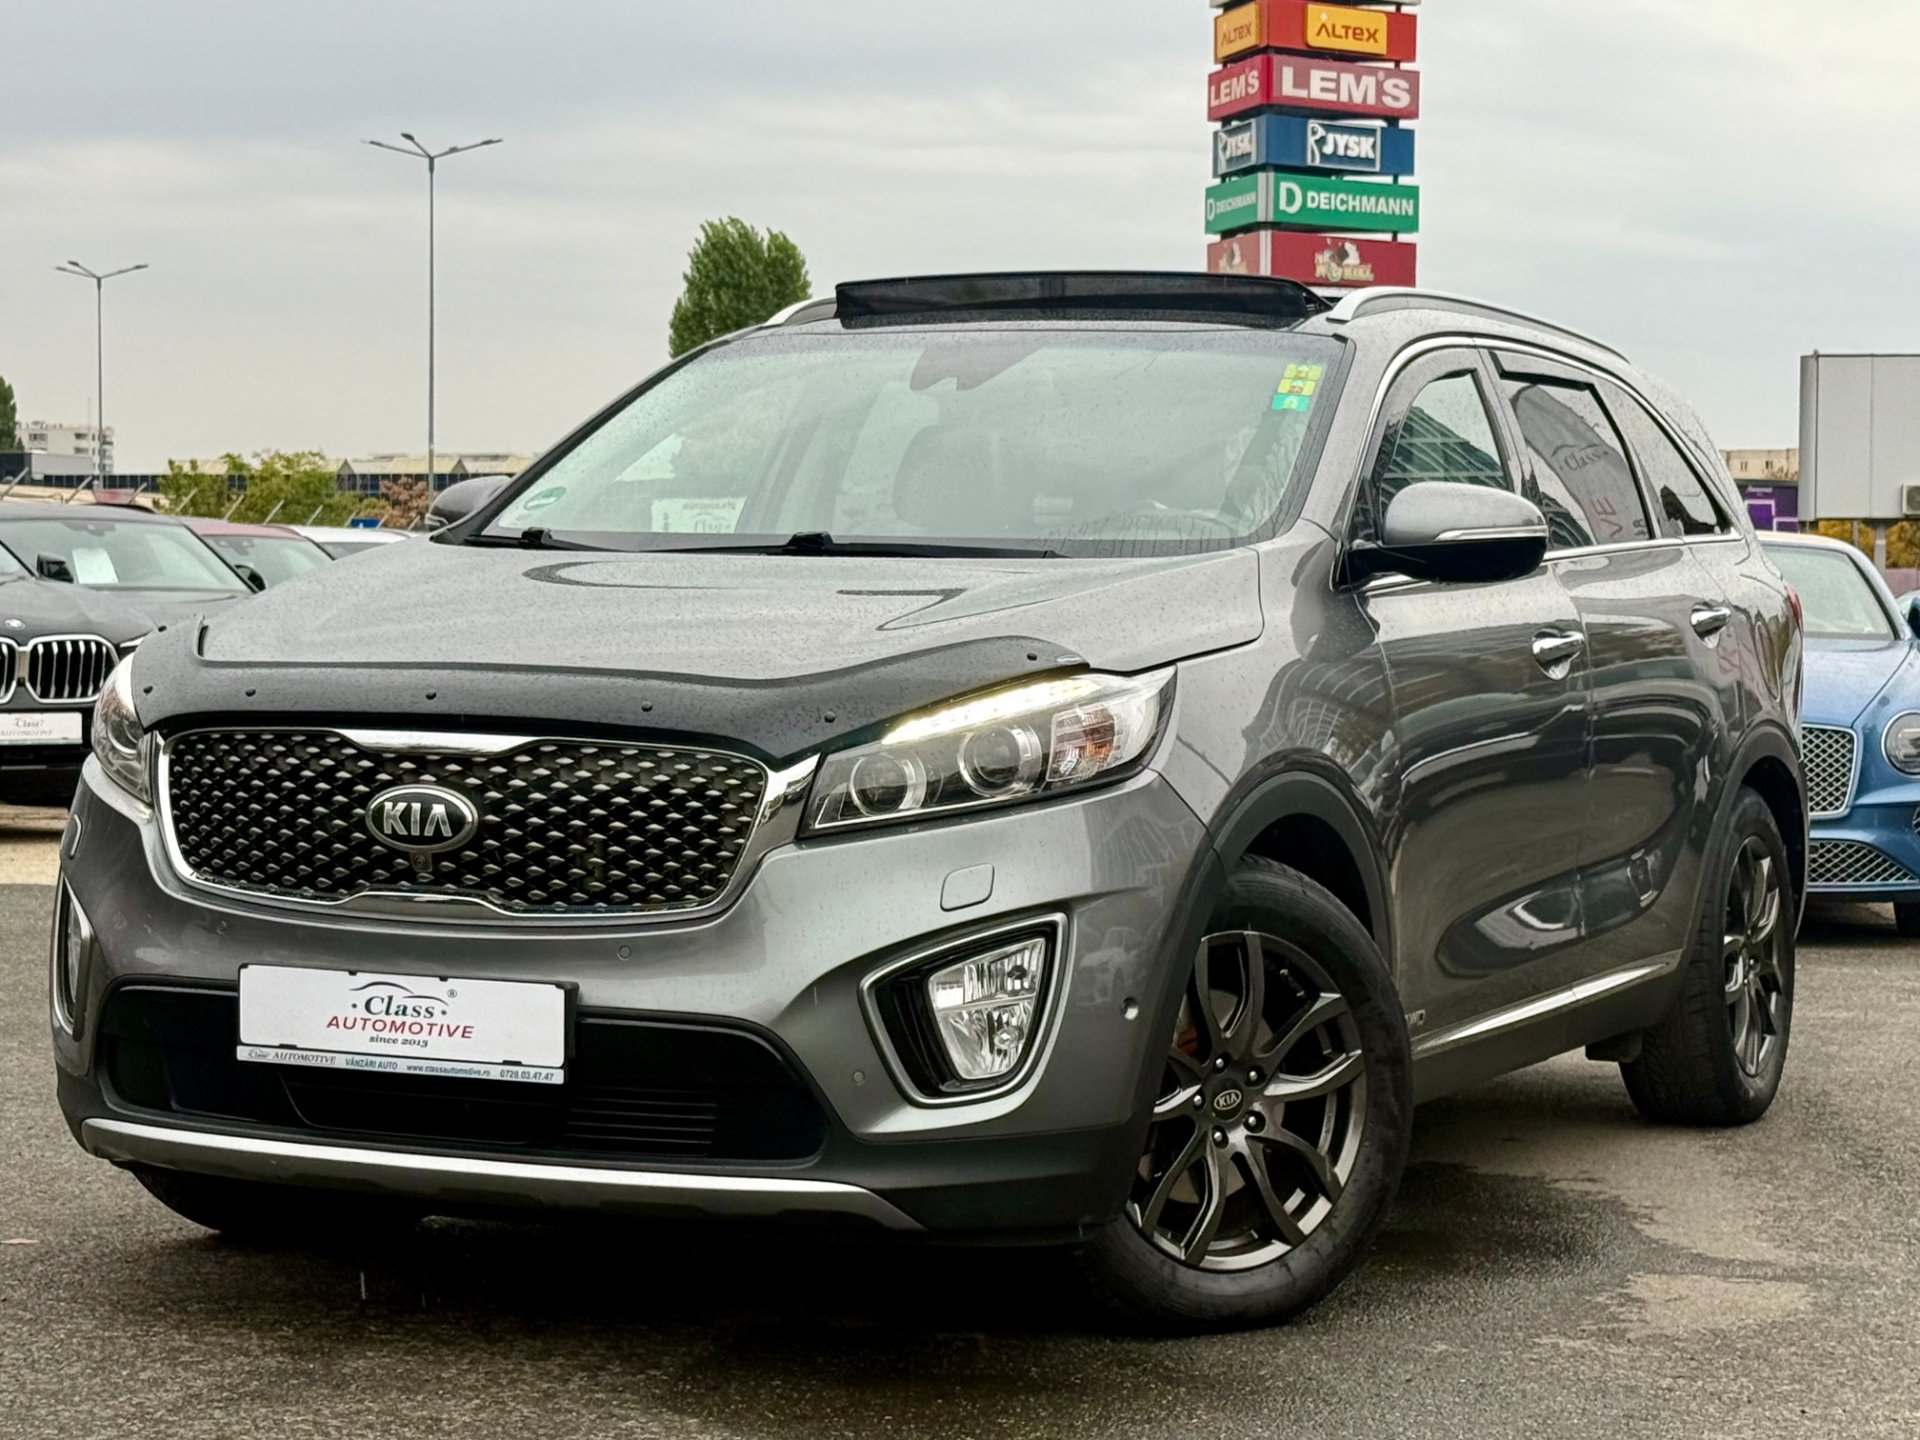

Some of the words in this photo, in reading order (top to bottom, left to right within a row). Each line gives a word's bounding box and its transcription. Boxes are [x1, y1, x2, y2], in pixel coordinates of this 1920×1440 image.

[1282, 66, 1411, 108] LEM'S
[1322, 133, 1375, 159] JYSK
[1307, 191, 1414, 216] DEICHMANN
[383, 801, 453, 837] KIA
[364, 995, 435, 1019] Class
[326, 1015, 475, 1039] AUTOMOTIVE
[369, 1034, 399, 1045] since
[400, 1037, 429, 1048] 2013
[272, 1051, 336, 1064] AUTOMOTIVE
[377, 1061, 399, 1070] AUTO
[1219, 1092, 1238, 1107] KIA
